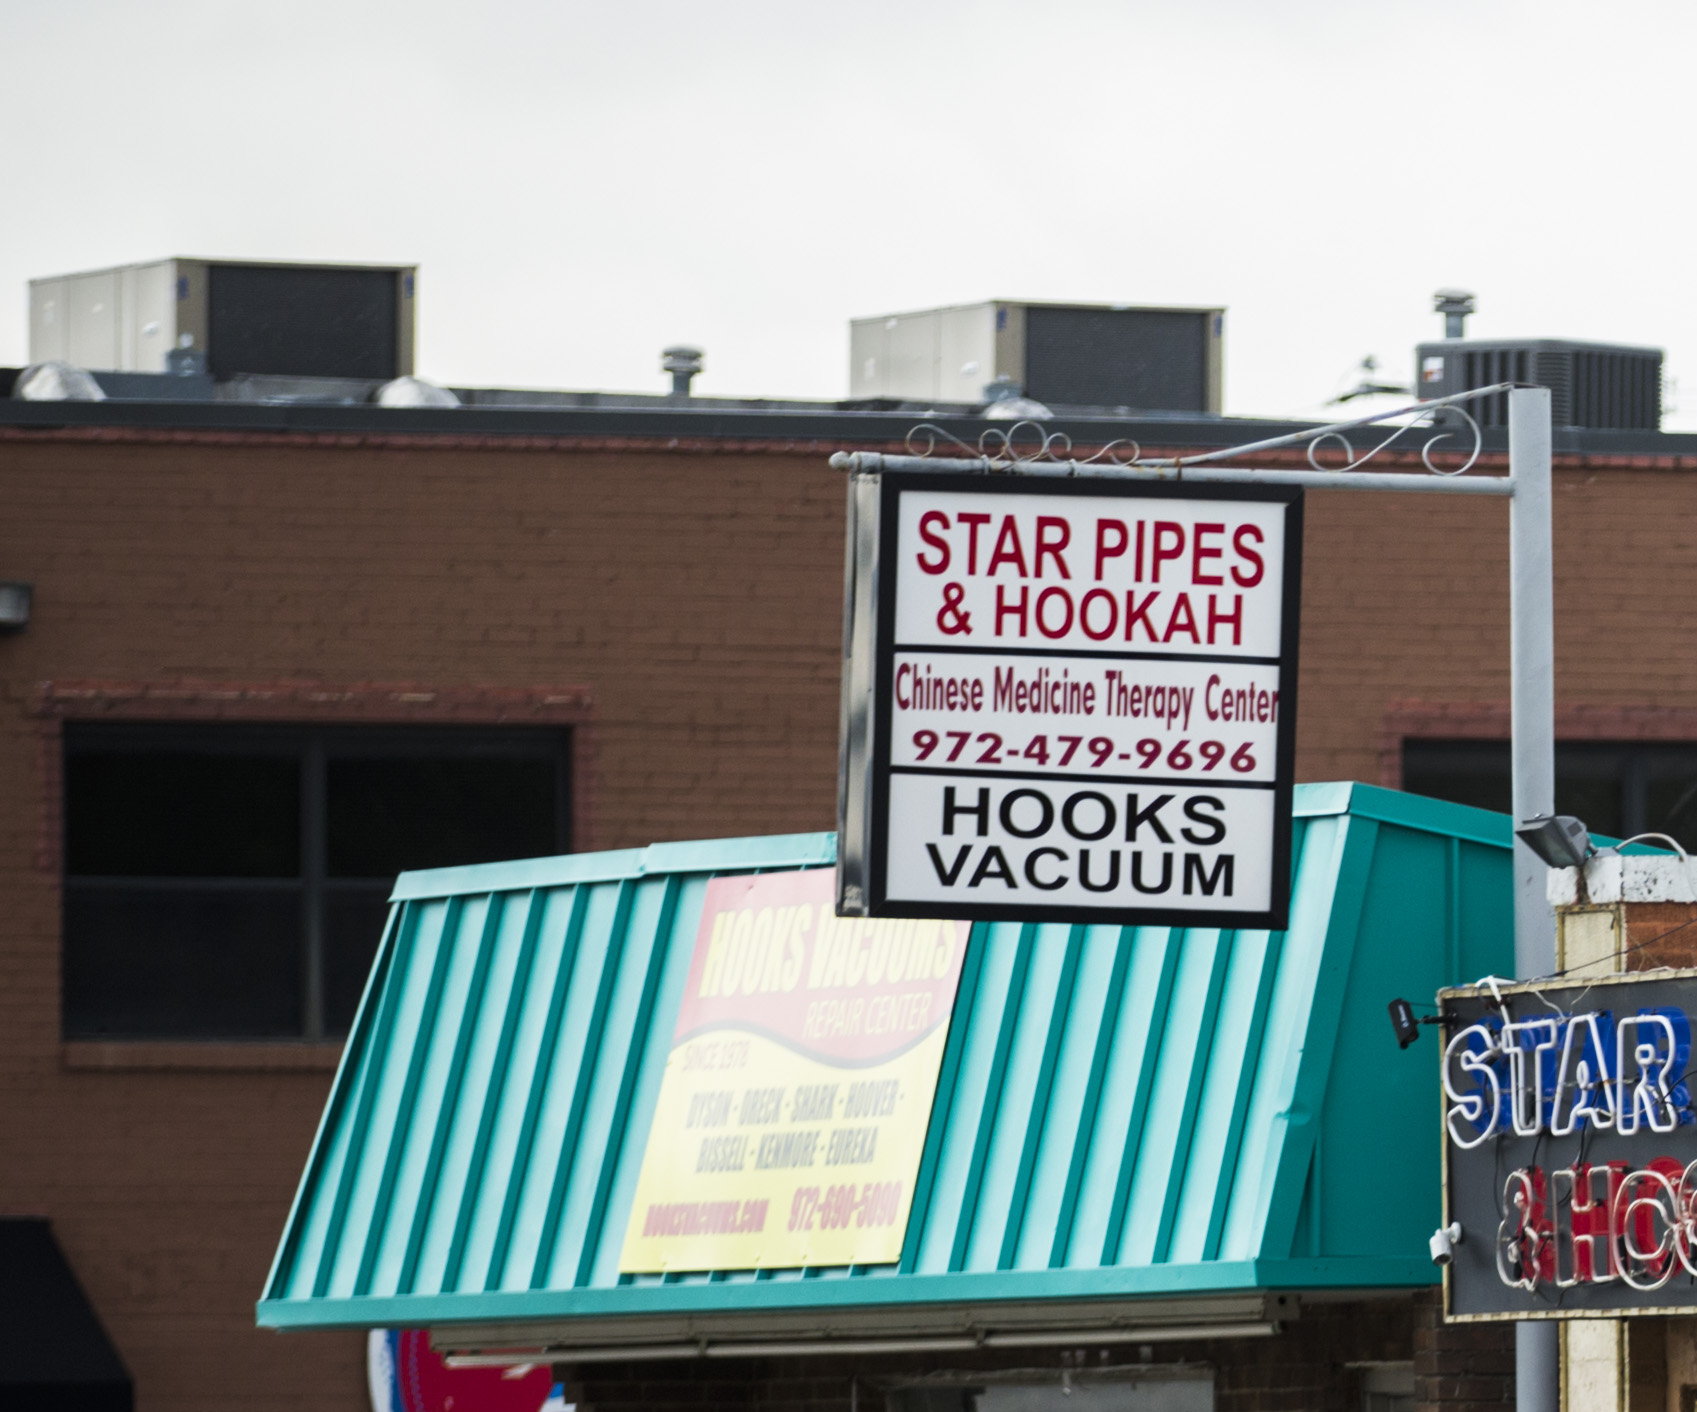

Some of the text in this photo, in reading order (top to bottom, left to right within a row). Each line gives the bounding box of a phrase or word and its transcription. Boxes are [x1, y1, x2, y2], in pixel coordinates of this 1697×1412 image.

[917, 510, 1266, 588] STAR PIPES
[936, 581, 1243, 646] & HOOKAH
[895, 662, 1279, 730] Chinese Medicine Therapy Center
[911, 729, 1257, 773] 972-479-9696
[942, 786, 1227, 847] HOOKS
[926, 843, 1235, 897] VACUUM
[698, 901, 957, 999] HOOKS VACUUMS
[802, 991, 934, 1041] REPAIR CENTER
[686, 1078, 900, 1129] DYSON ORECK SHARK HOOVER
[1443, 1010, 1690, 1149] STAR
[695, 1126, 879, 1174] BISSELL KENMORE EUREKA
